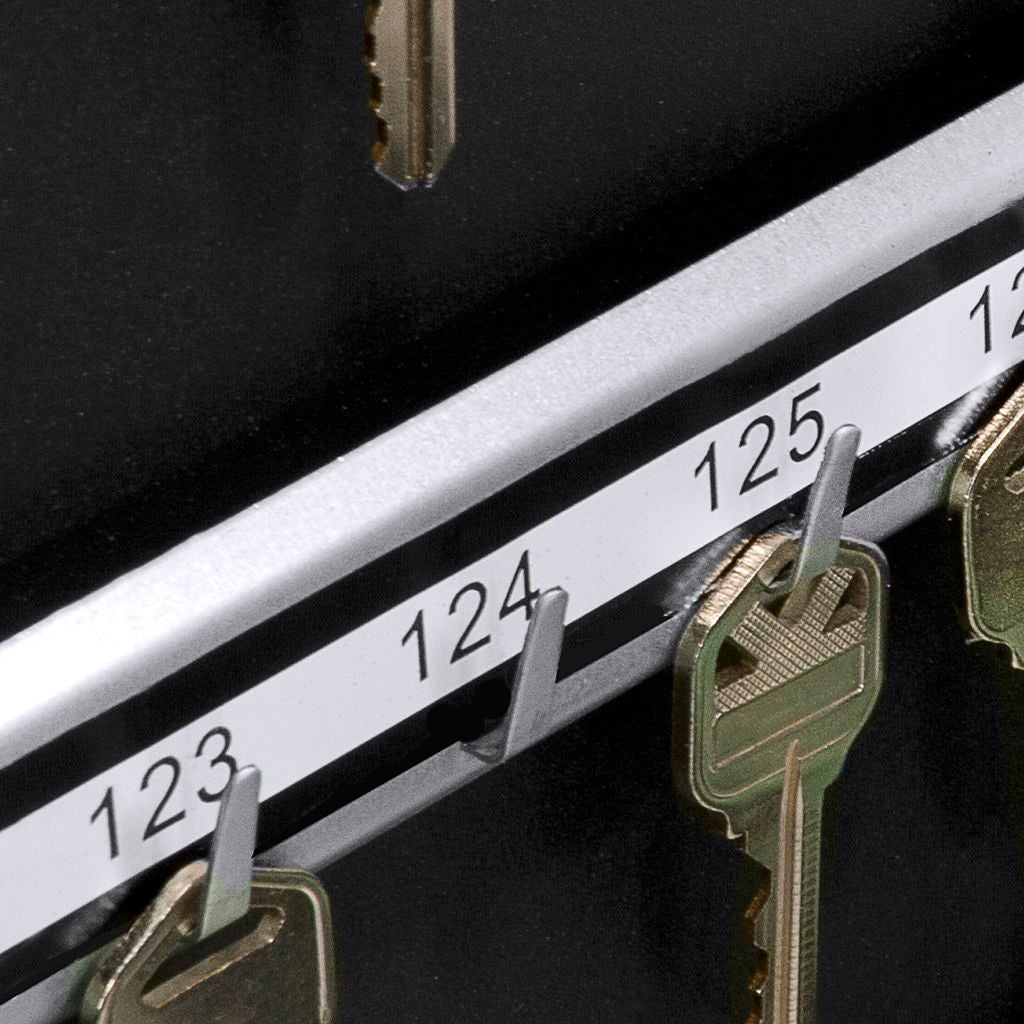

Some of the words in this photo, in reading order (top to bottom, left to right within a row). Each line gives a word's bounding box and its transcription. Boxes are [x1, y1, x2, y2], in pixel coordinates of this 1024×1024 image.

[90, 725, 238, 859] 123
[402, 549, 540, 682] 124
[694, 382, 825, 512] 125
